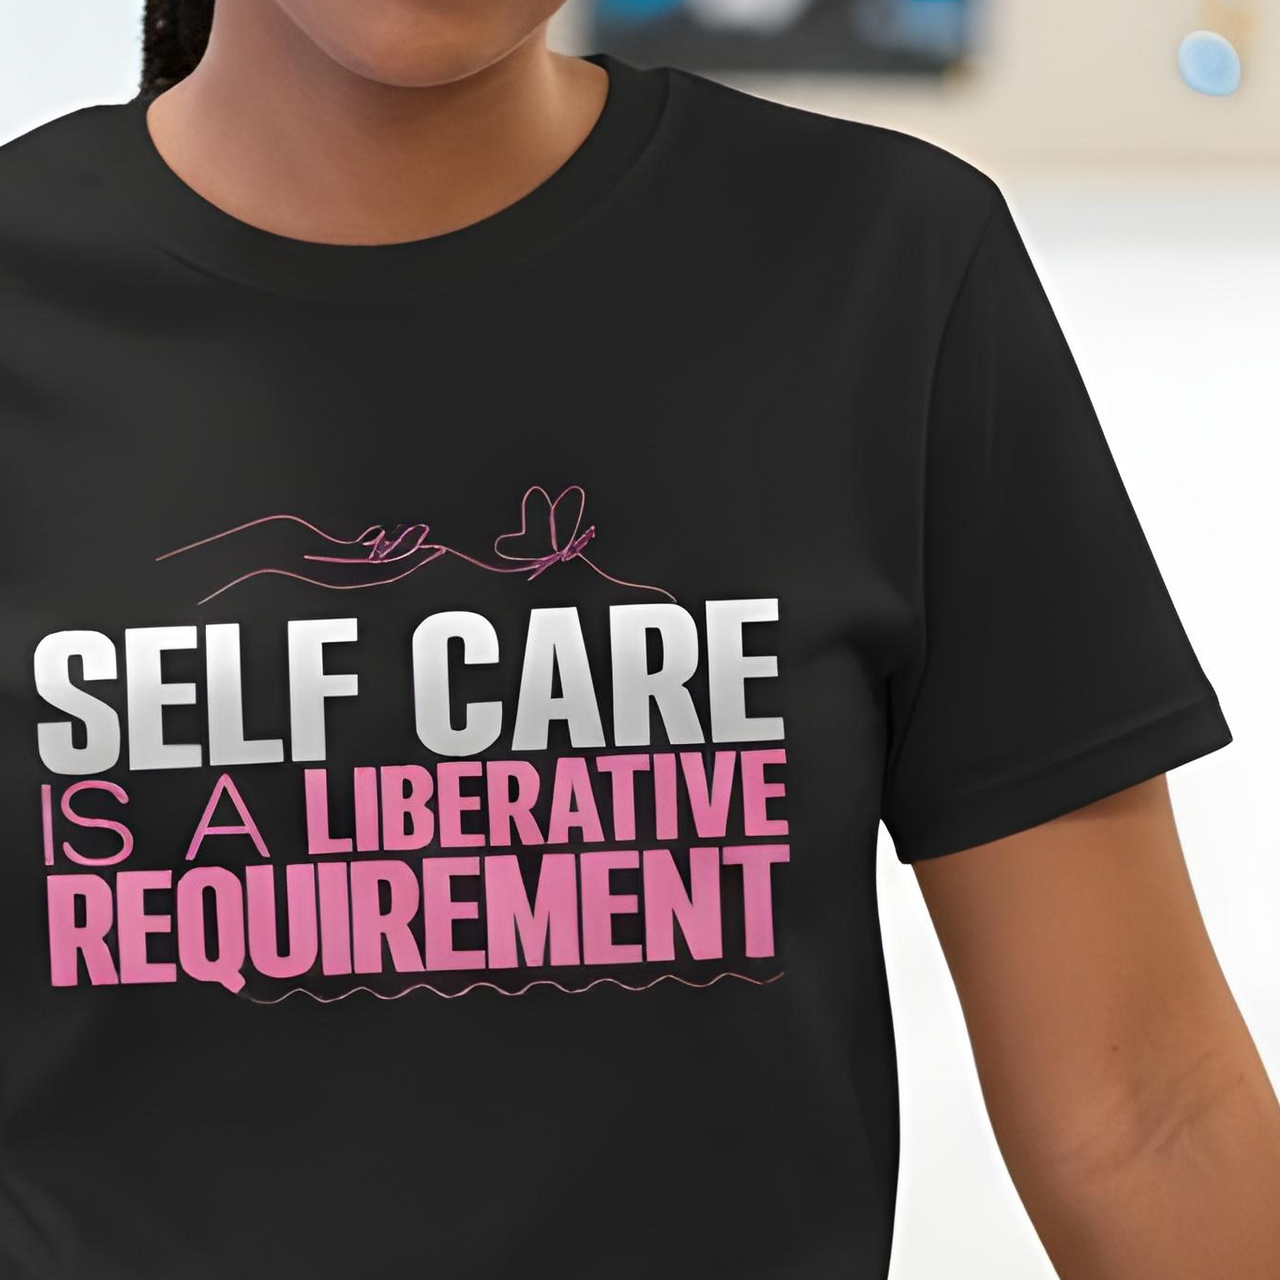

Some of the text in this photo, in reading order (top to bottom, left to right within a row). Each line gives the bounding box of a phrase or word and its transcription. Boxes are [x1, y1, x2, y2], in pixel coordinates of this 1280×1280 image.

[33, 597, 786, 776] SELF CARE
[41, 749, 790, 866] IS A LIBERATIVE
[47, 844, 791, 994] REQUIREMENT
